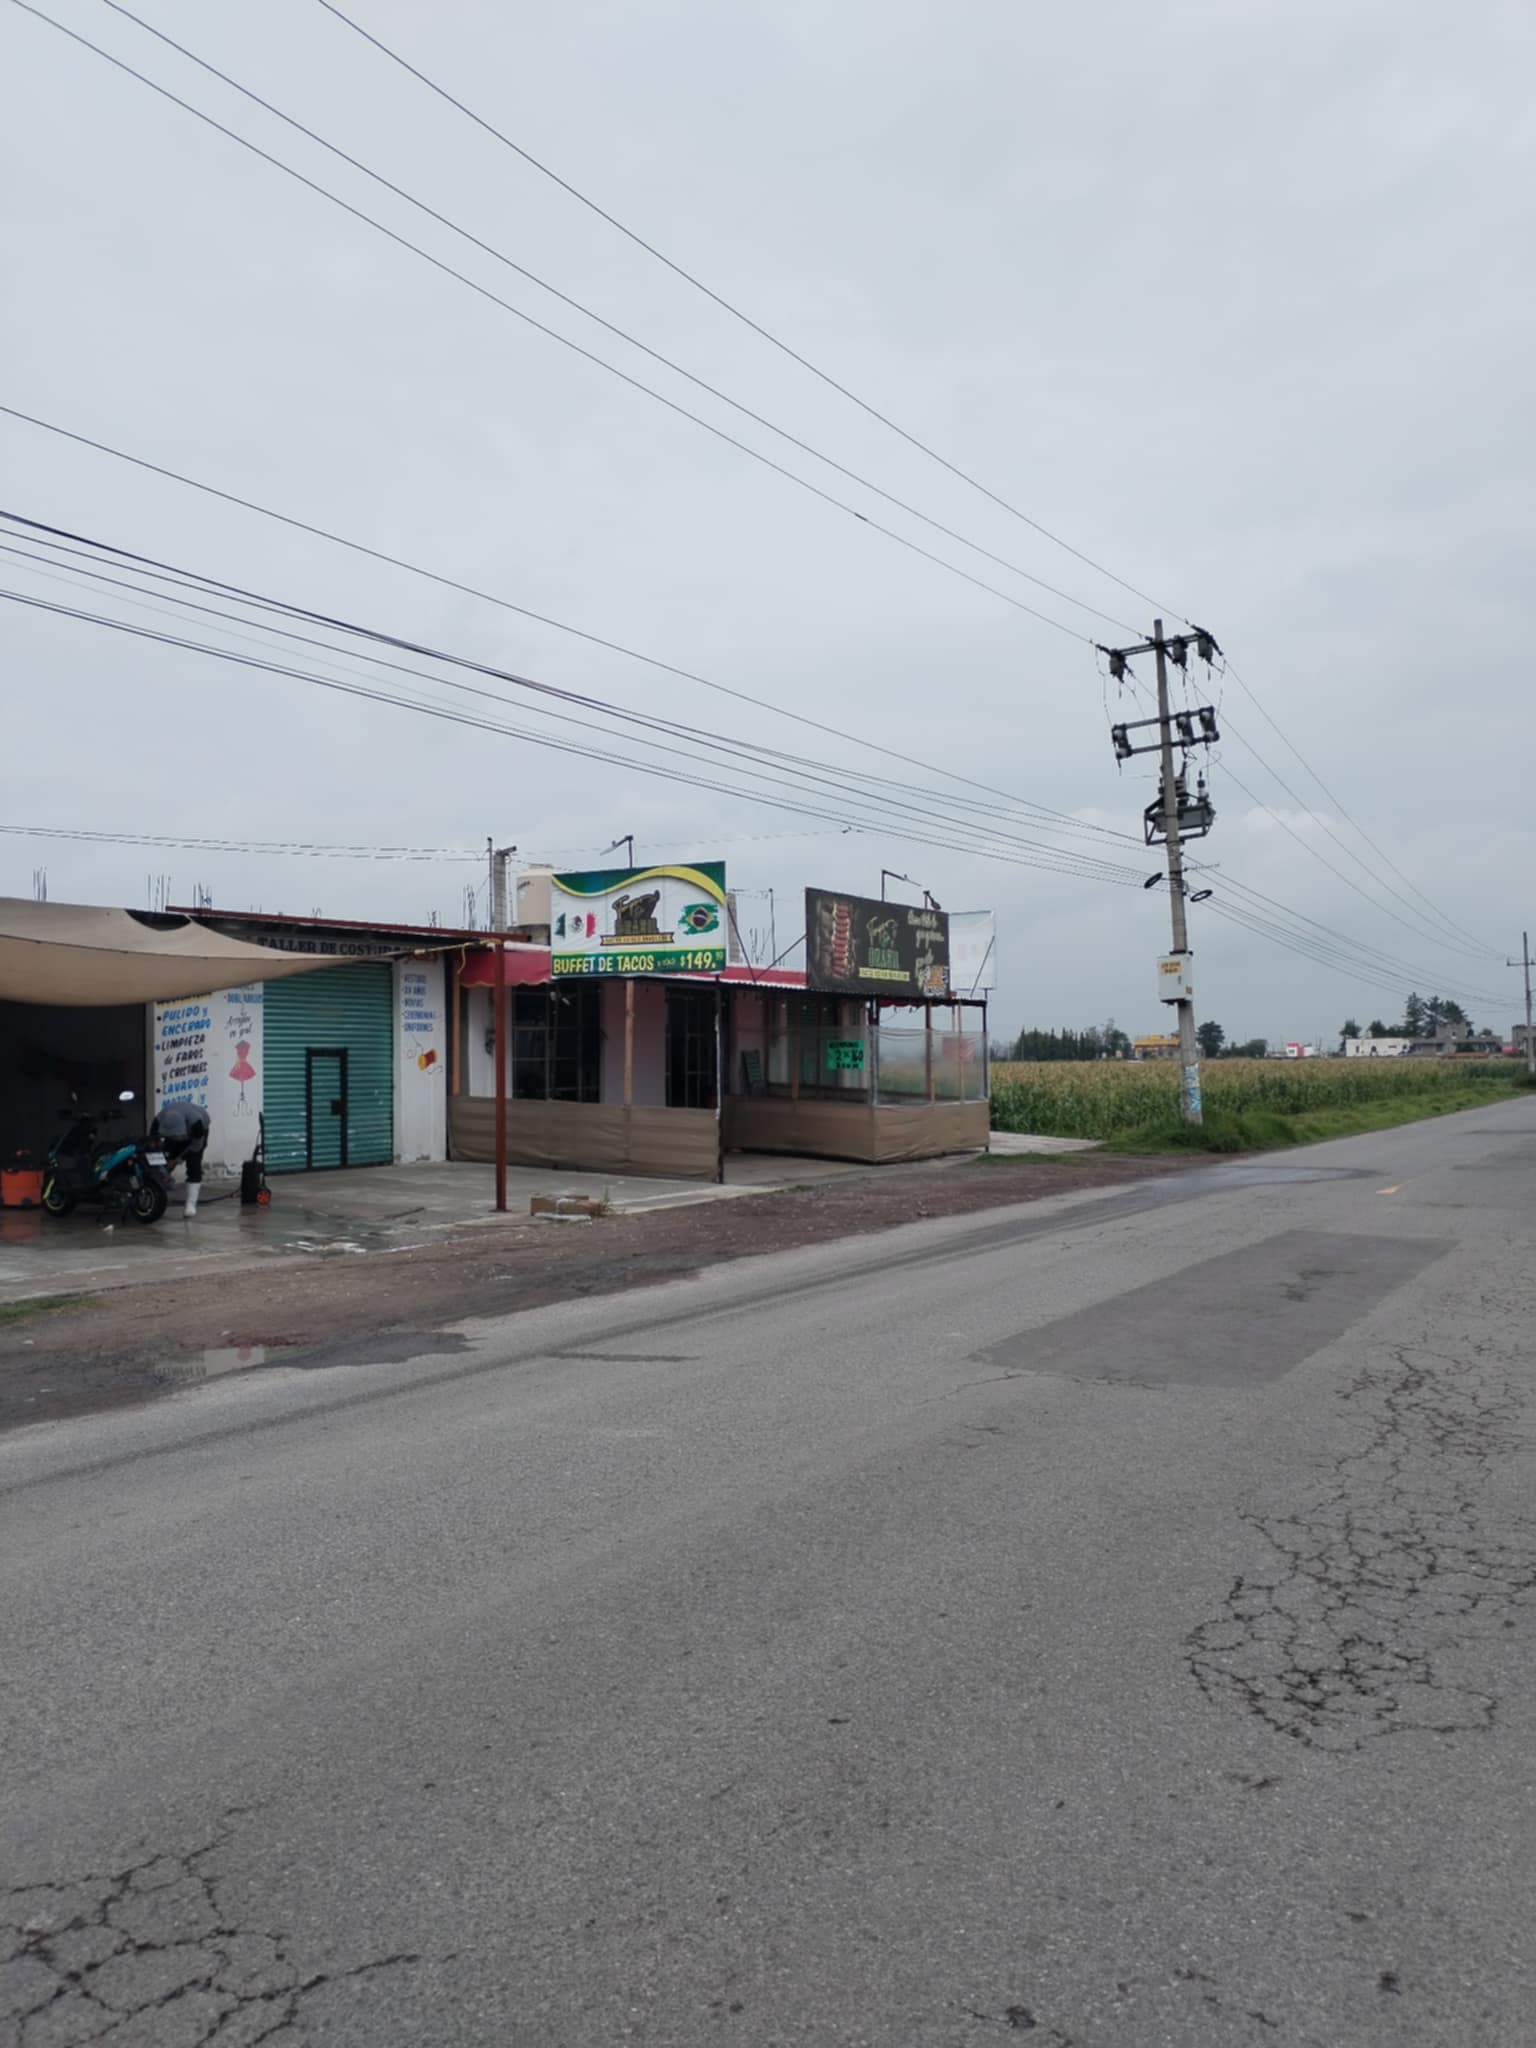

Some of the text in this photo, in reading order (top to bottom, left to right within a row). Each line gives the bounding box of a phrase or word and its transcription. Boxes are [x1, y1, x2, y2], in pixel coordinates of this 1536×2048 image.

[257, 936, 316, 953] TALLER
[321, 942, 337, 954] DE
[553, 956, 594, 974] BUFFET
[599, 956, 613, 972] DE
[616, 955, 654, 972] TACOS
[163, 1006, 200, 1022] PULIDO
[161, 1034, 205, 1051] LIMPIEZA
[175, 1048, 203, 1063] FAROS
[162, 1078, 200, 1095] LAVADO
